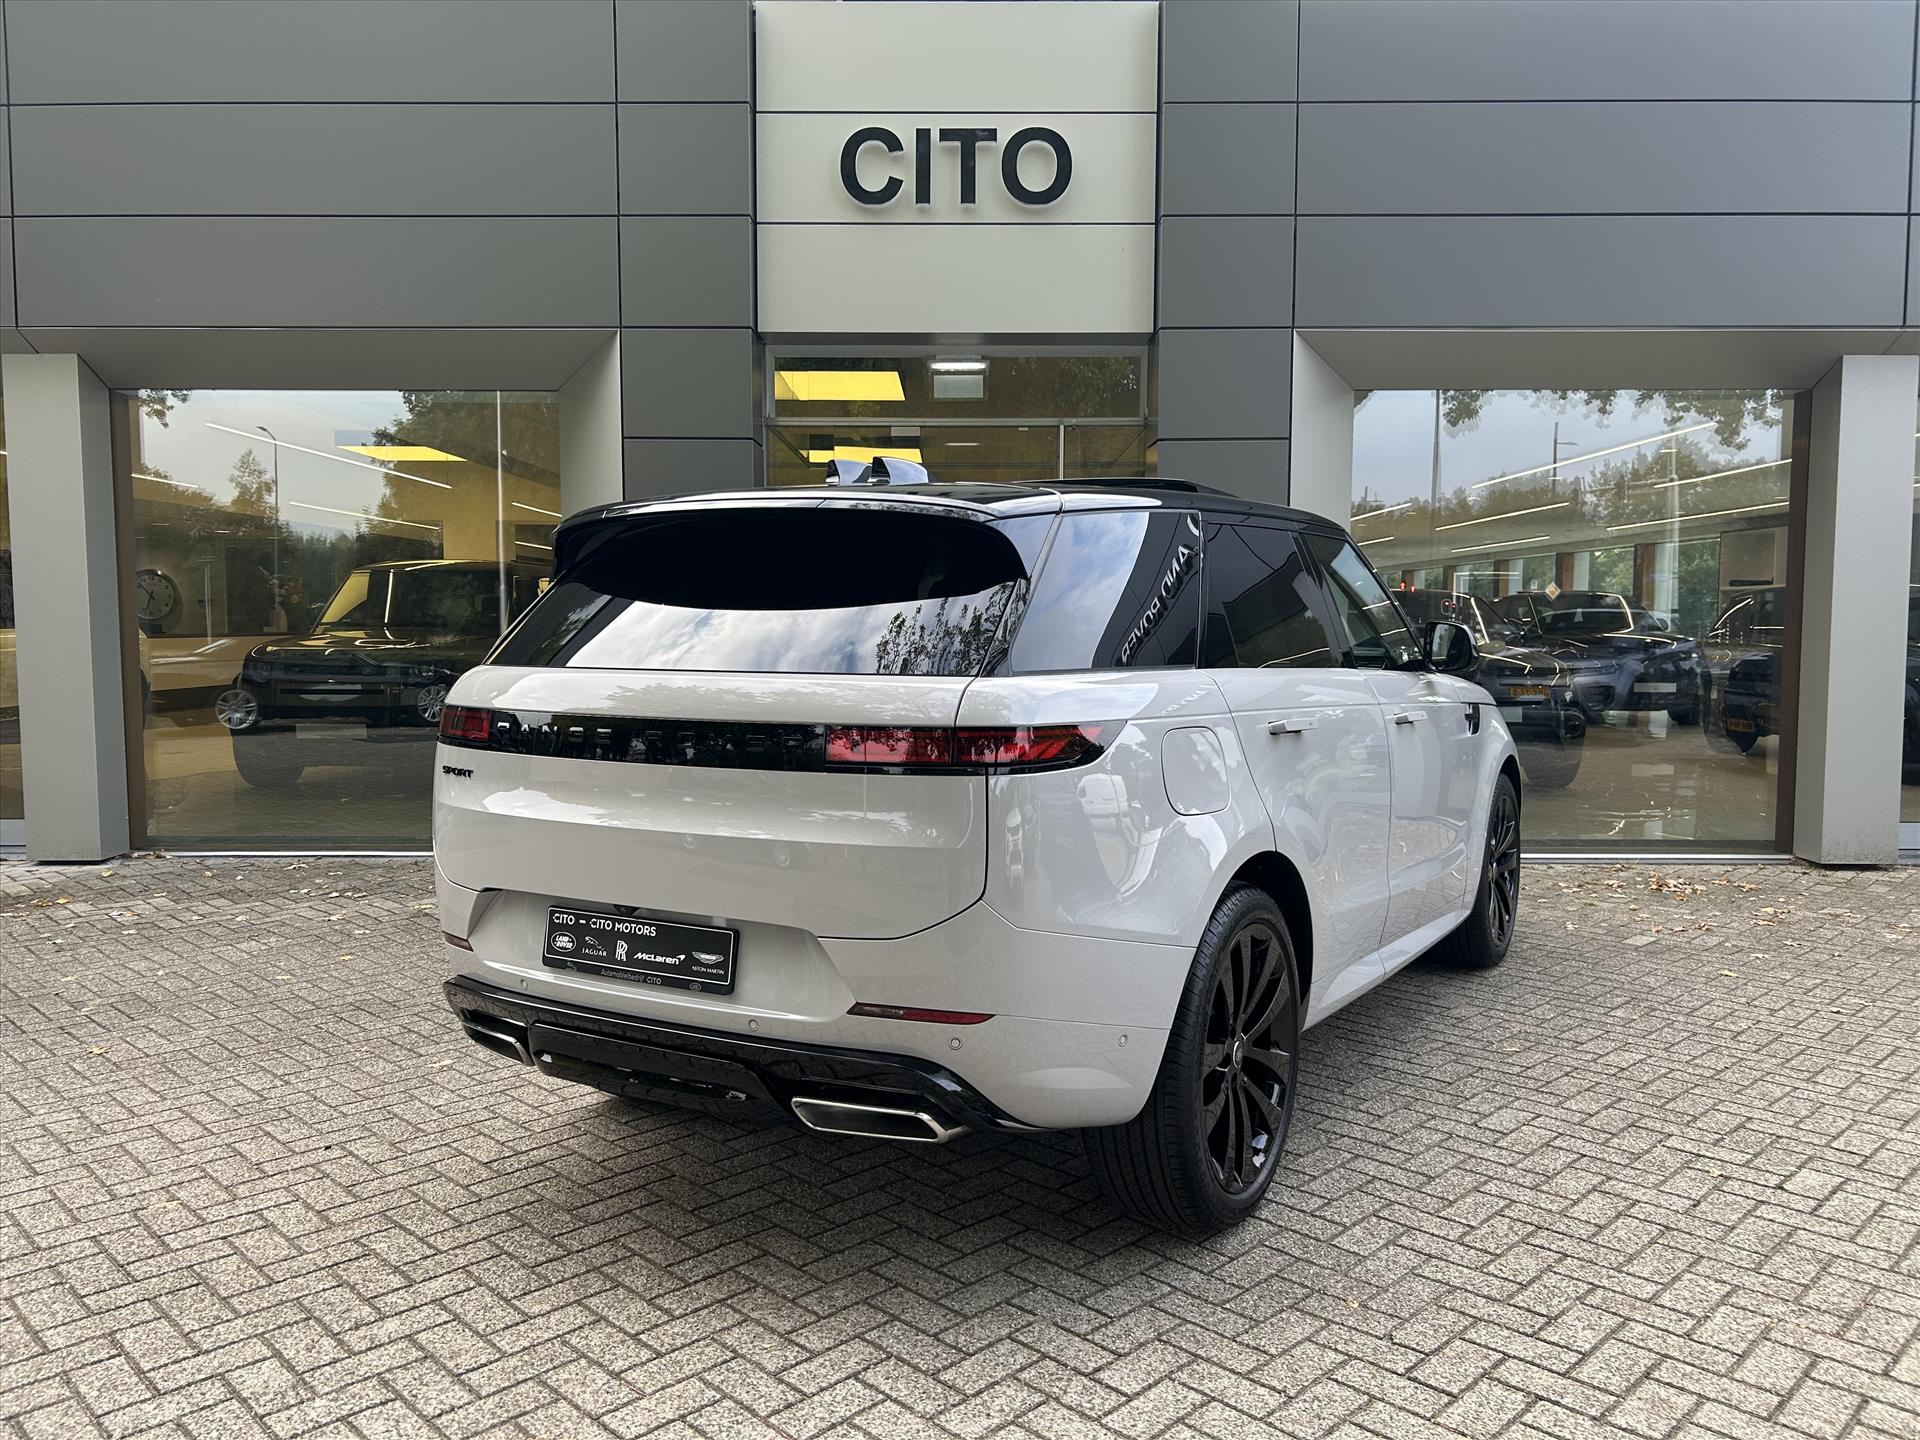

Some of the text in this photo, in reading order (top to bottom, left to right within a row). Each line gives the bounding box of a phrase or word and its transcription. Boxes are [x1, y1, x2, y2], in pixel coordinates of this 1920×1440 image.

[840, 127, 1073, 205] CITO
[442, 765, 474, 779] SPORT
[553, 913, 575, 925] CITO
[590, 918, 612, 930] CITO
[615, 922, 657, 937] MOTORS
[582, 947, 607, 957] JAGUAR
[633, 952, 679, 965] McLaren
[646, 976, 662, 985] CITO
